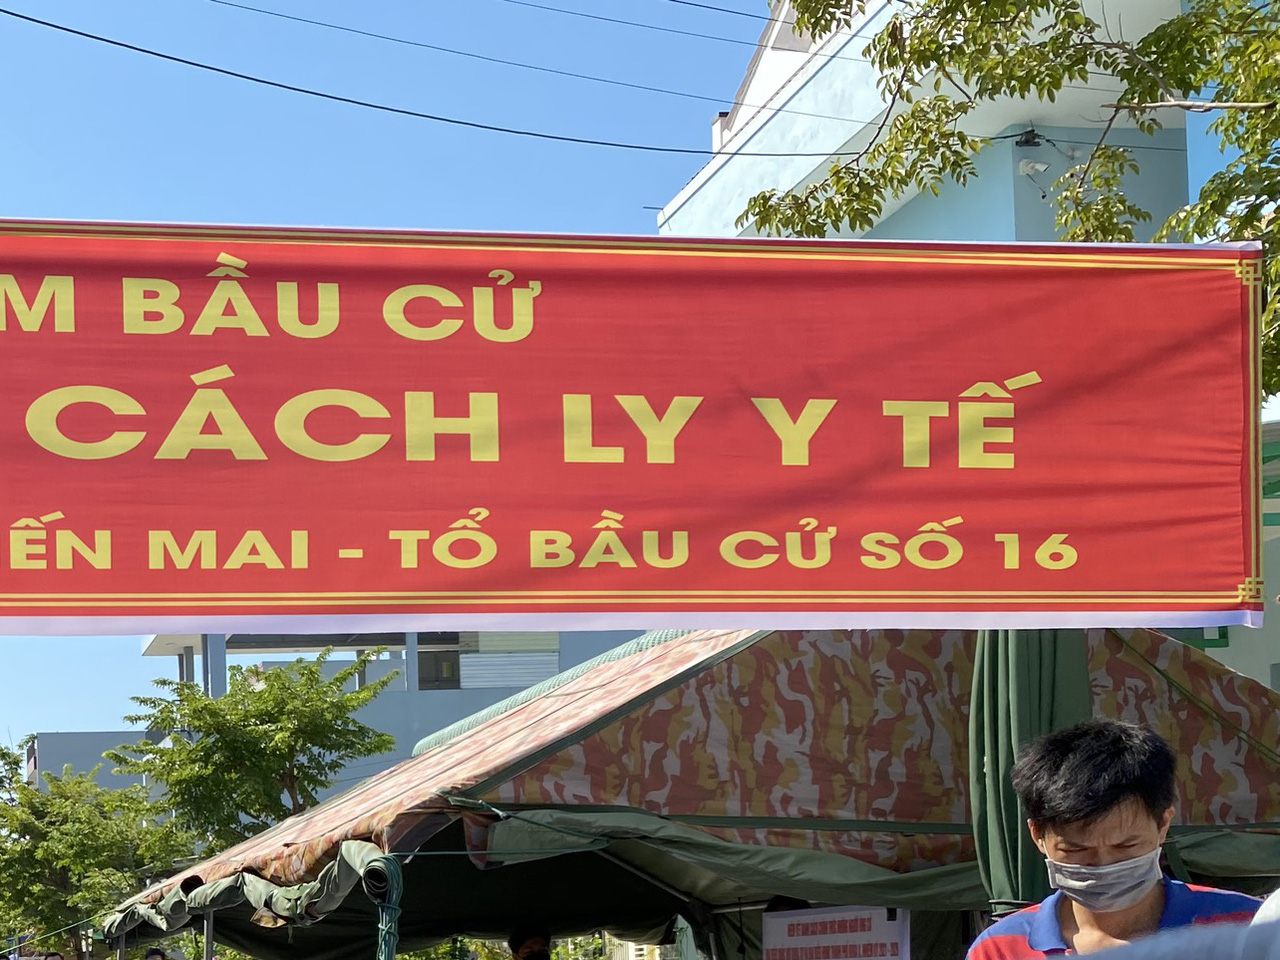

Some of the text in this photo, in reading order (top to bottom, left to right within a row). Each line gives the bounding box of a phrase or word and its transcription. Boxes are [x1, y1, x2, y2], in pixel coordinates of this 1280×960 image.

[122, 252, 341, 338] BẦU
[381, 269, 542, 344] CỬ
[24, 364, 501, 463] CÁCH
[561, 393, 705, 464] LY
[751, 397, 838, 467] Y
[882, 370, 1043, 470] TẾ
[147, 528, 309, 570] MAI
[337, 548, 364, 559] -
[388, 506, 498, 570] TỔ
[529, 509, 690, 570] BẦU
[718, 517, 838, 570] CỬ
[859, 515, 964, 570] SỐ
[994, 532, 1079, 571] 16
